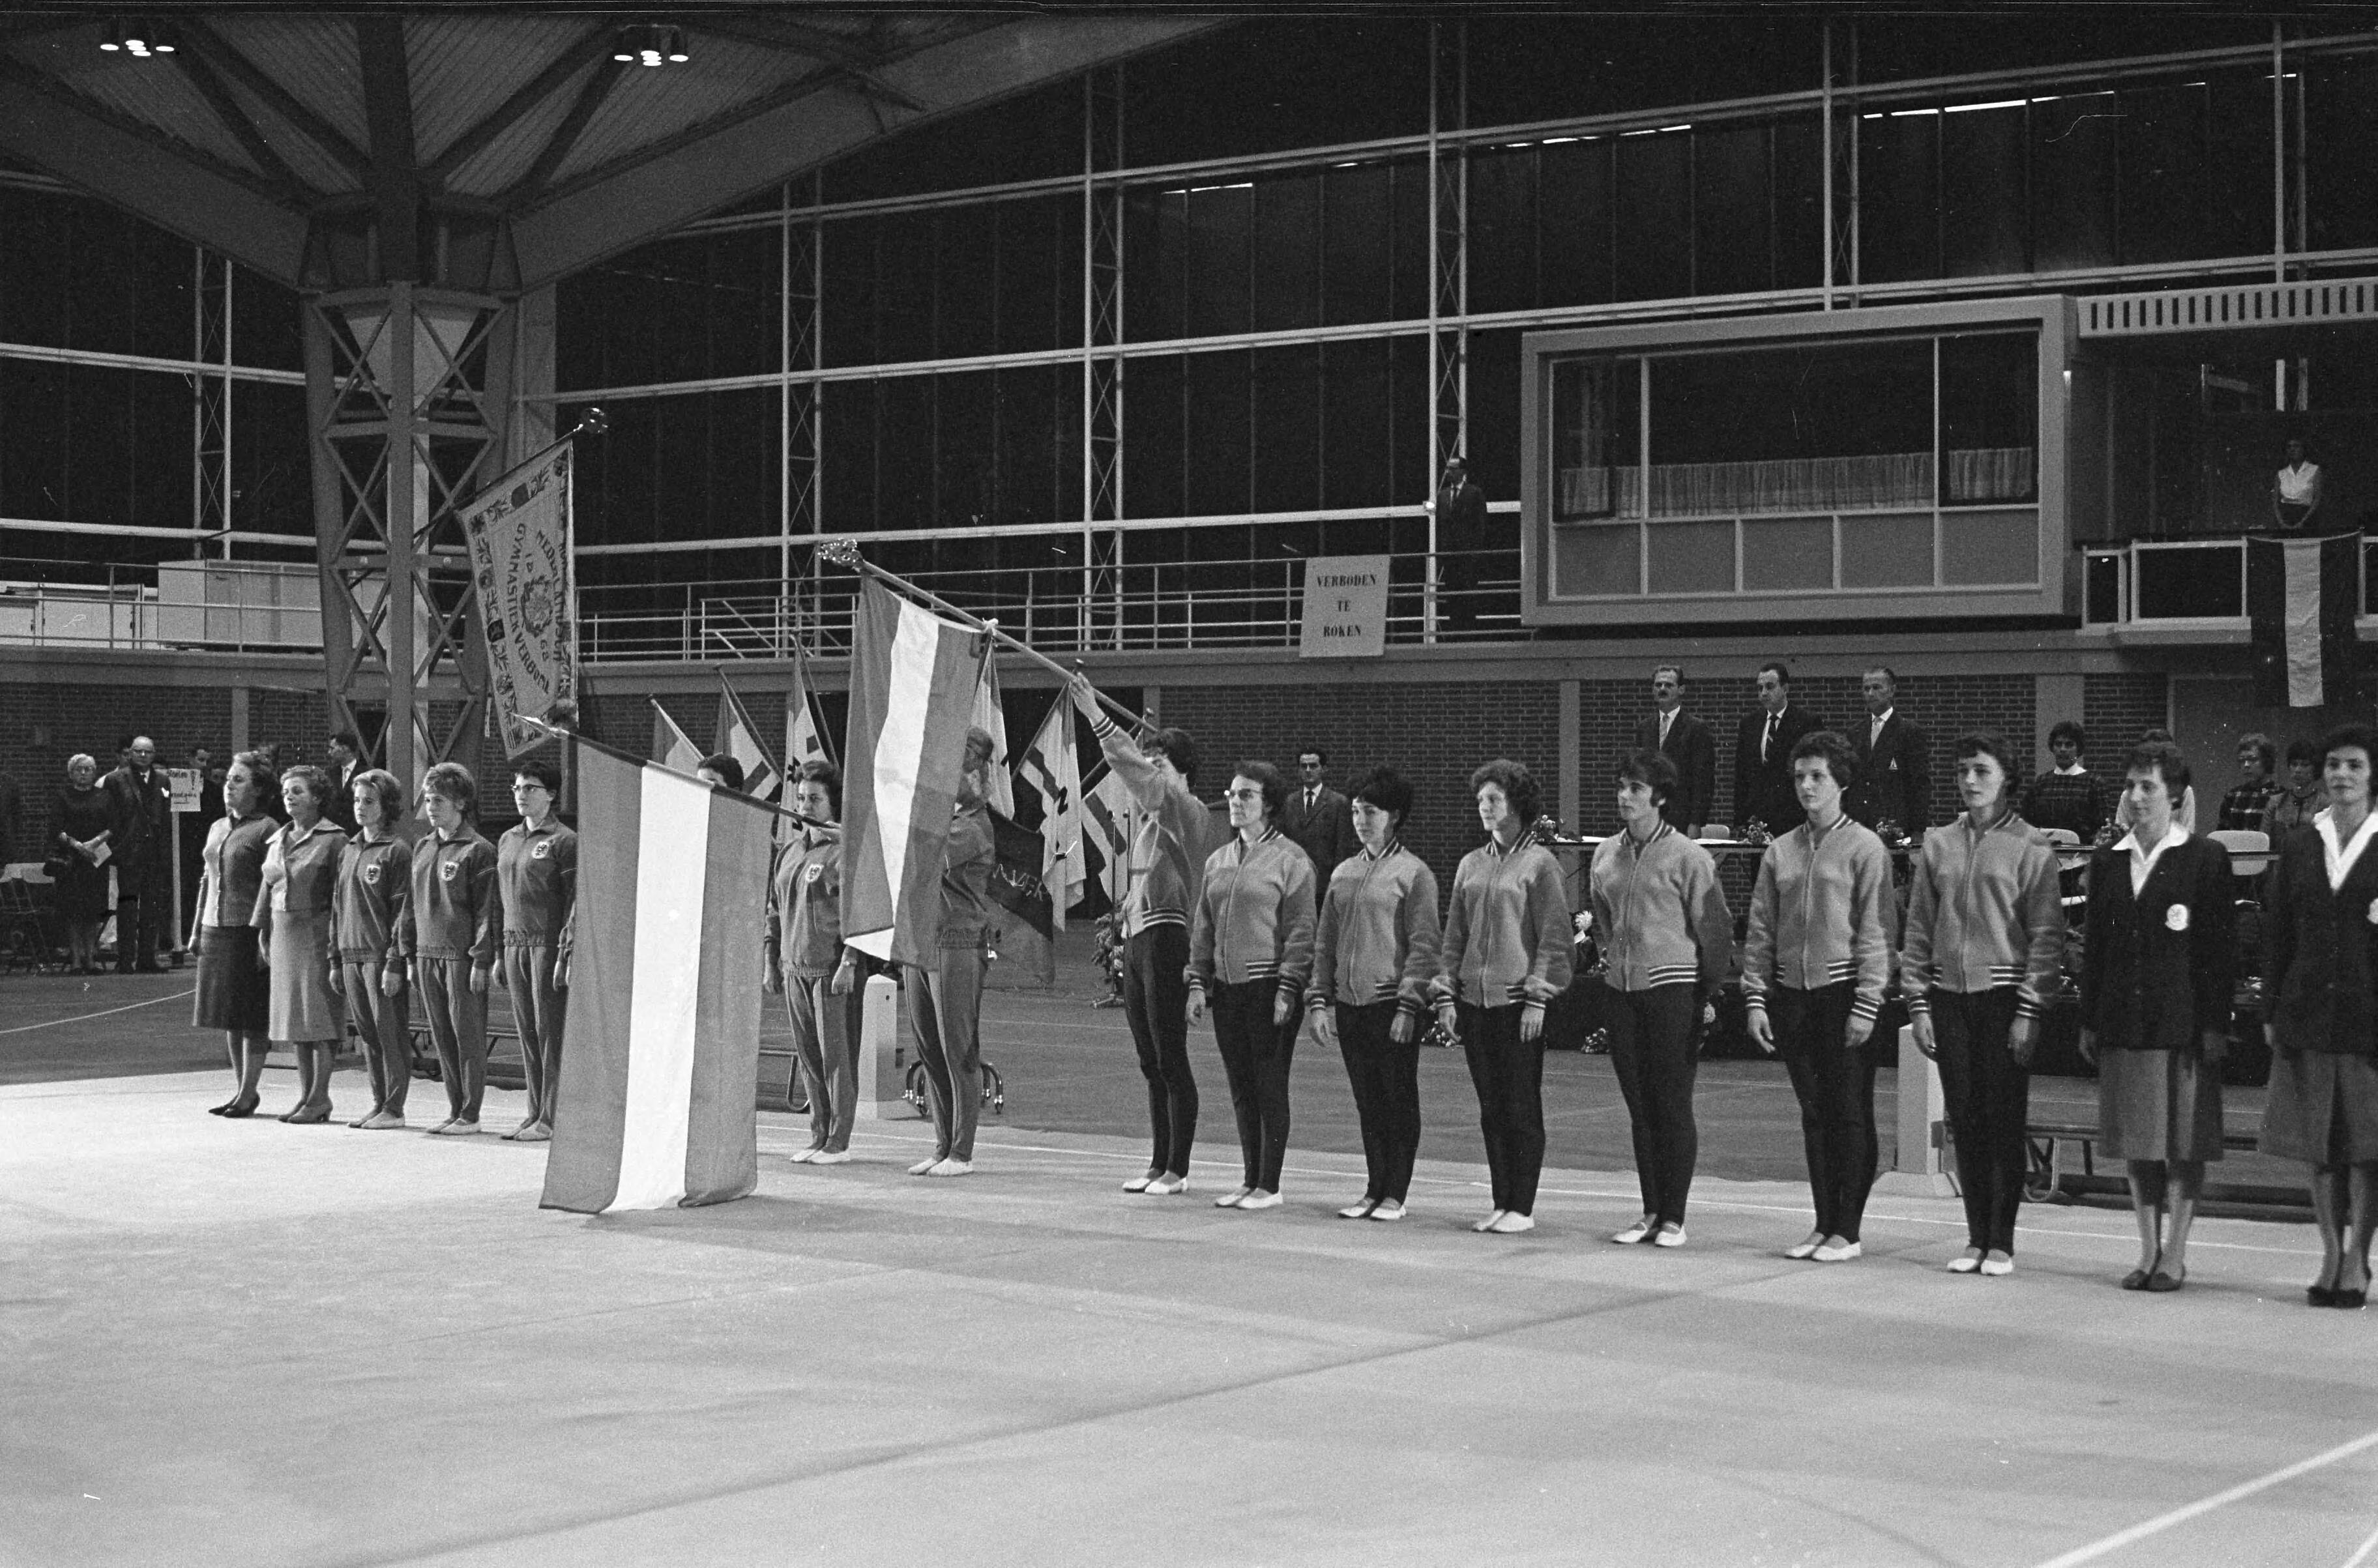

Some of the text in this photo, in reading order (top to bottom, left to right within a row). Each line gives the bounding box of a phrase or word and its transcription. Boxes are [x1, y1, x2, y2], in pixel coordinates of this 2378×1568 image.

[1317, 574, 1377, 587] VERBODEN
[1338, 600, 1351, 612] TE
[1323, 625, 1362, 638] ROKEN
